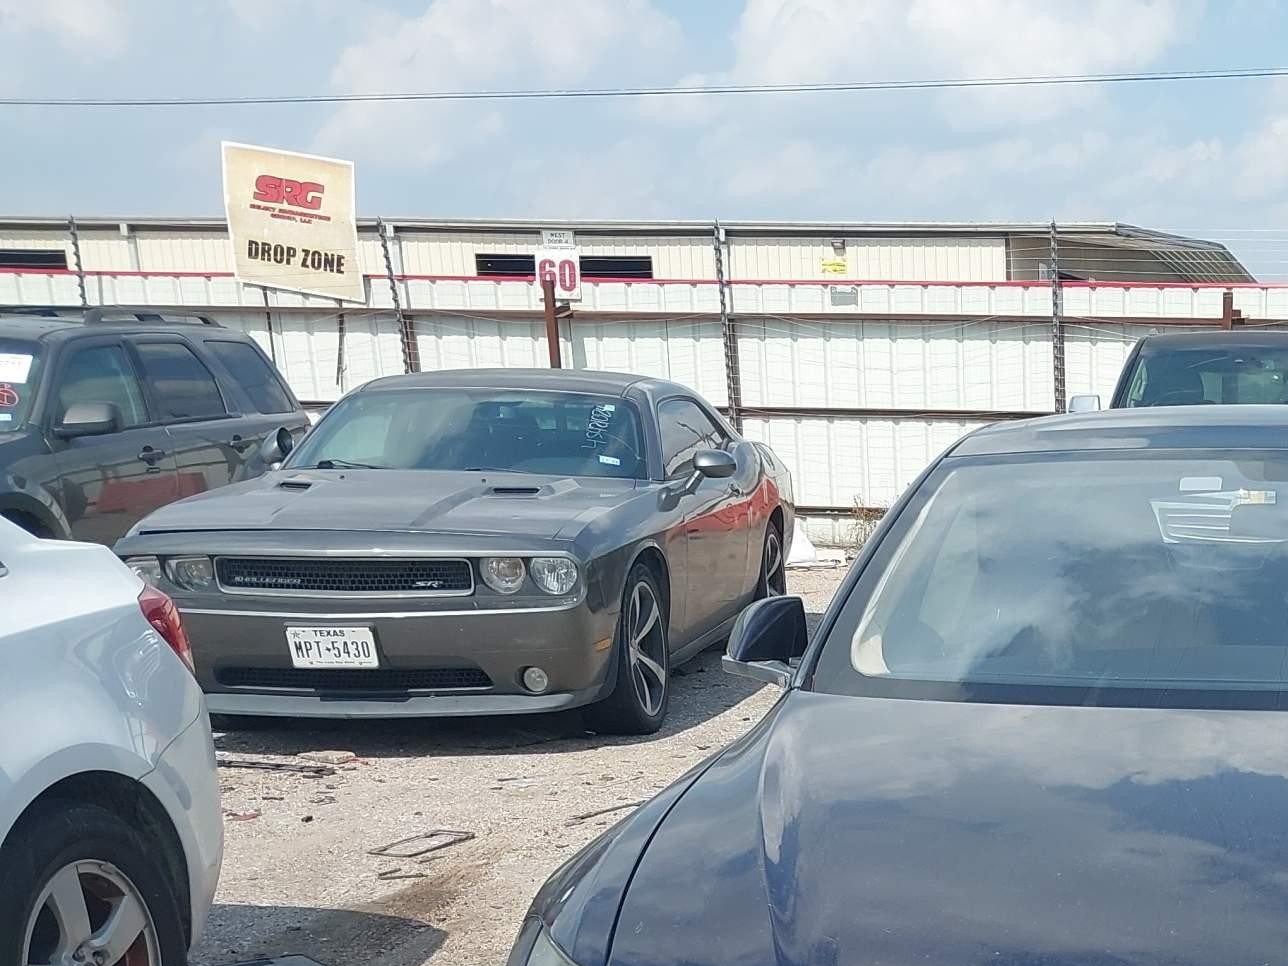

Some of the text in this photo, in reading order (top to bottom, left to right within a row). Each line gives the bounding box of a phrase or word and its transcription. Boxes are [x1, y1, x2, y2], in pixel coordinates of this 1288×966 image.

[253, 174, 325, 210] SRG
[247, 239, 345, 274] DROP ZONE
[538, 258, 577, 292] 60
[312, 629, 345, 637] TEXAS
